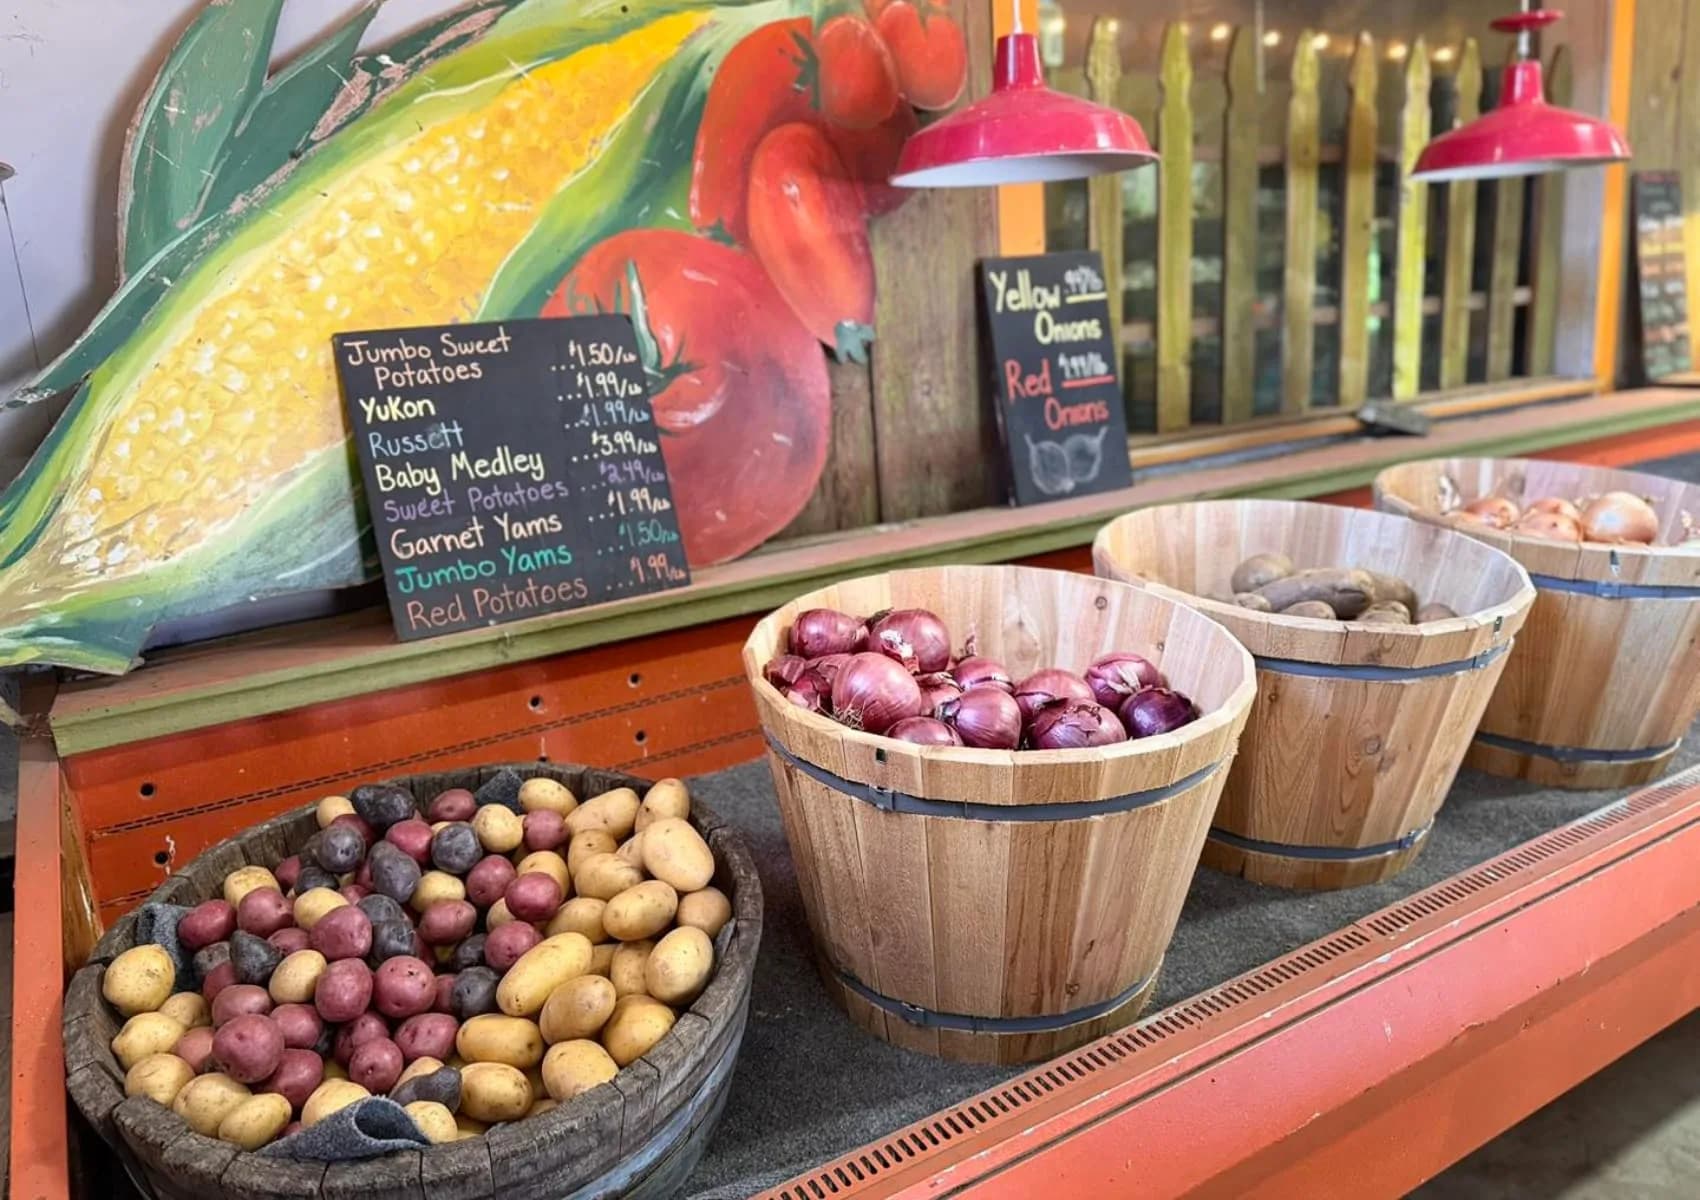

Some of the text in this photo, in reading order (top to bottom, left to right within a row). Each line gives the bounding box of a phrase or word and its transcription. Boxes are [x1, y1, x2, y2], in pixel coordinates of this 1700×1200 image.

[989, 269, 1061, 313] Yellow
[344, 326, 512, 366] Jumbo Sweet
[1034, 310, 1102, 345] Onions
[374, 358, 483, 391] Potatoes
[1003, 358, 1052, 404] Red
[1044, 397, 1110, 431] Onions
[375, 461, 441, 496] Baby
[451, 445, 545, 481] Medley
[384, 487, 456, 523] Sweet
[467, 480, 569, 512] Potatoes
[390, 515, 485, 560] Garnet
[493, 512, 563, 542] Yams
[395, 559, 496, 593] Jumbo
[501, 544, 572, 576] Yams
[406, 594, 467, 631] Red
[473, 577, 588, 618] Potatoes
